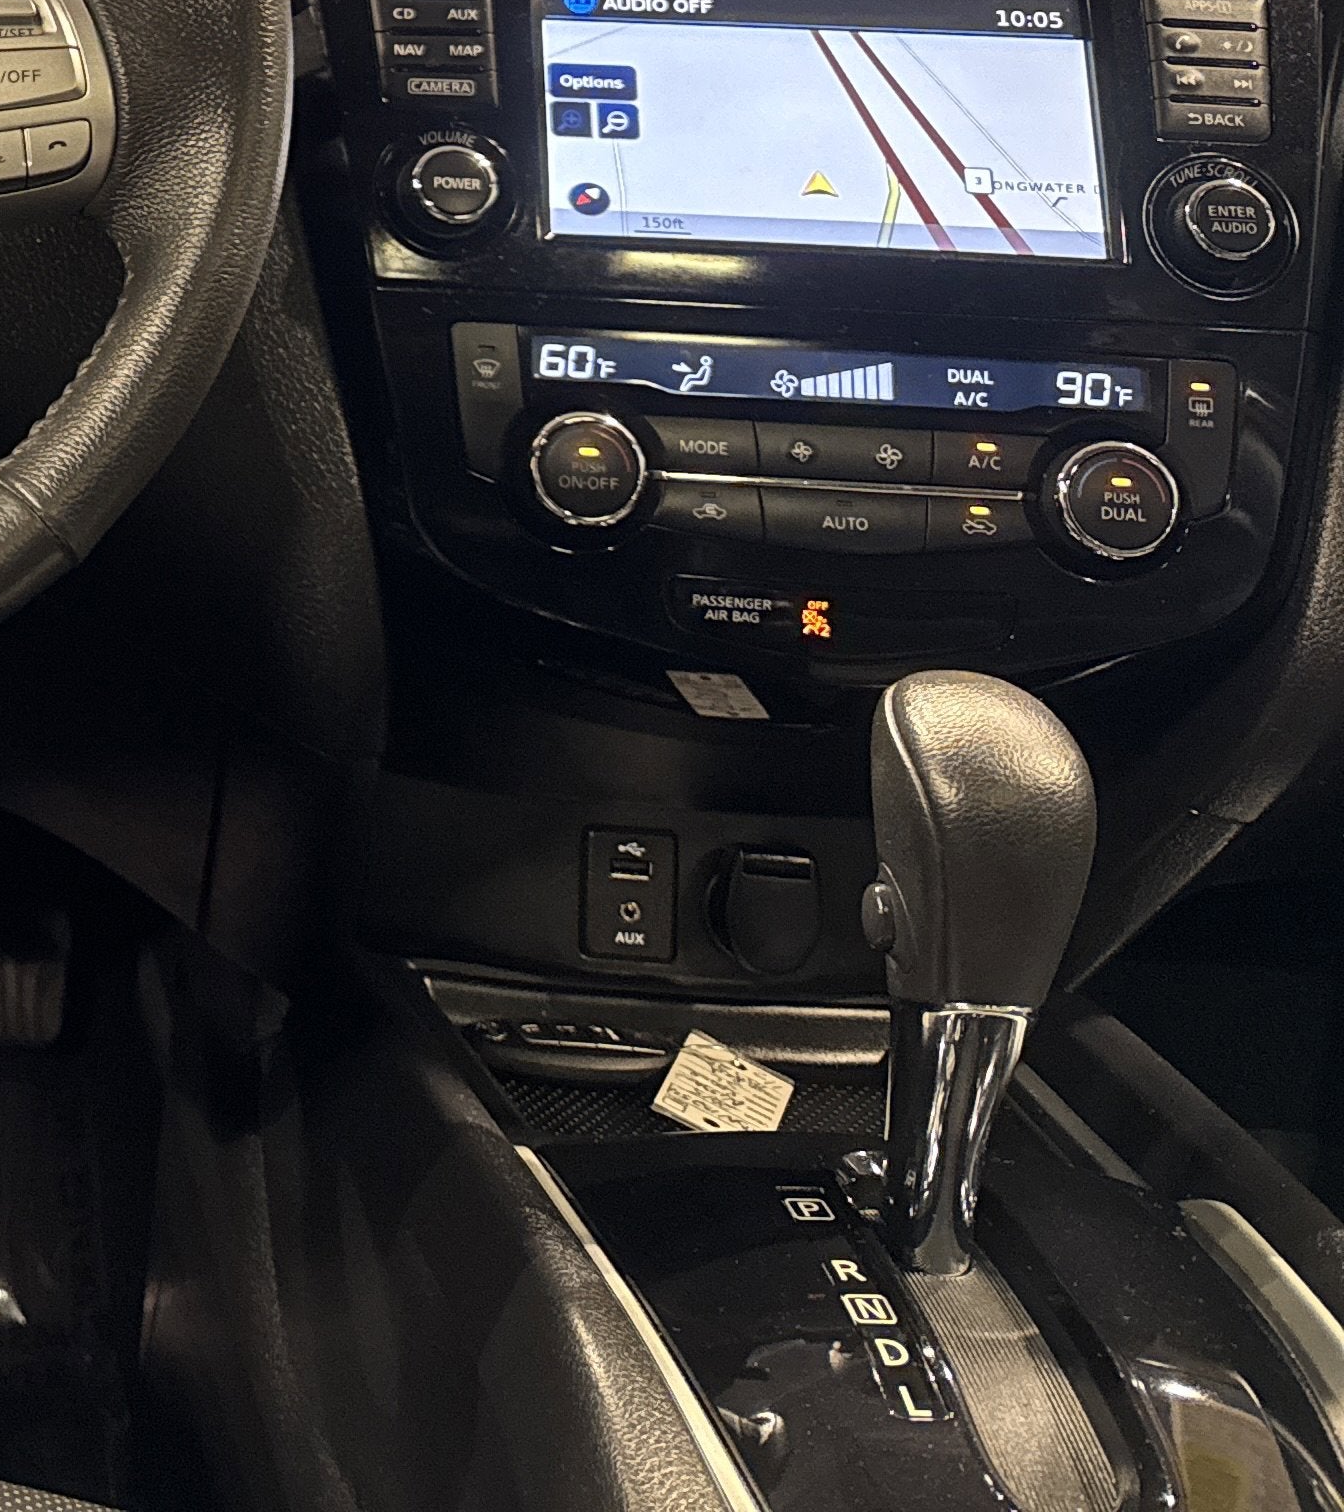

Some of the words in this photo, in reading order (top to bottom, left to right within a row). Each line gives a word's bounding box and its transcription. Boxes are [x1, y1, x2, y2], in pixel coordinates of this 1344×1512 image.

[392, 7, 415, 20] CD
[447, 8, 478, 20] AUX
[996, 9, 1063, 29] 10:05
[393, 44, 425, 56] NAV
[449, 45, 484, 56] MAP
[411, 81, 472, 93] CAMERA
[559, 74, 625, 90] Options
[1204, 113, 1245, 127] BACK
[419, 130, 477, 148] VOLUME
[433, 176, 481, 190] POWER
[975, 177, 982, 185] 3
[993, 180, 1086, 194] ONGWATER
[1207, 206, 1256, 219] ENTER
[642, 216, 684, 231] 150ft
[1212, 222, 1258, 235] AUDIO
[947, 369, 994, 385] DUAL
[953, 391, 989, 408] A/C
[1188, 420, 1214, 428] REAR
[679, 440, 729, 455] MODE
[571, 461, 606, 474] PUSH
[968, 456, 1001, 471] A/C
[1104, 492, 1140, 504] PUSH
[1101, 506, 1147, 523] DUAL
[822, 516, 869, 531] AUTO
[692, 594, 772, 611] PASSENGER
[807, 600, 829, 610] OFF
[704, 609, 727, 621] AIR
[732, 611, 760, 624] BAG
[614, 931, 645, 946] AUX
[798, 1201, 819, 1217] P
[830, 1259, 867, 1282] R
[854, 1298, 888, 1320] N
[874, 1338, 909, 1366] D
[899, 1385, 933, 1417] L
